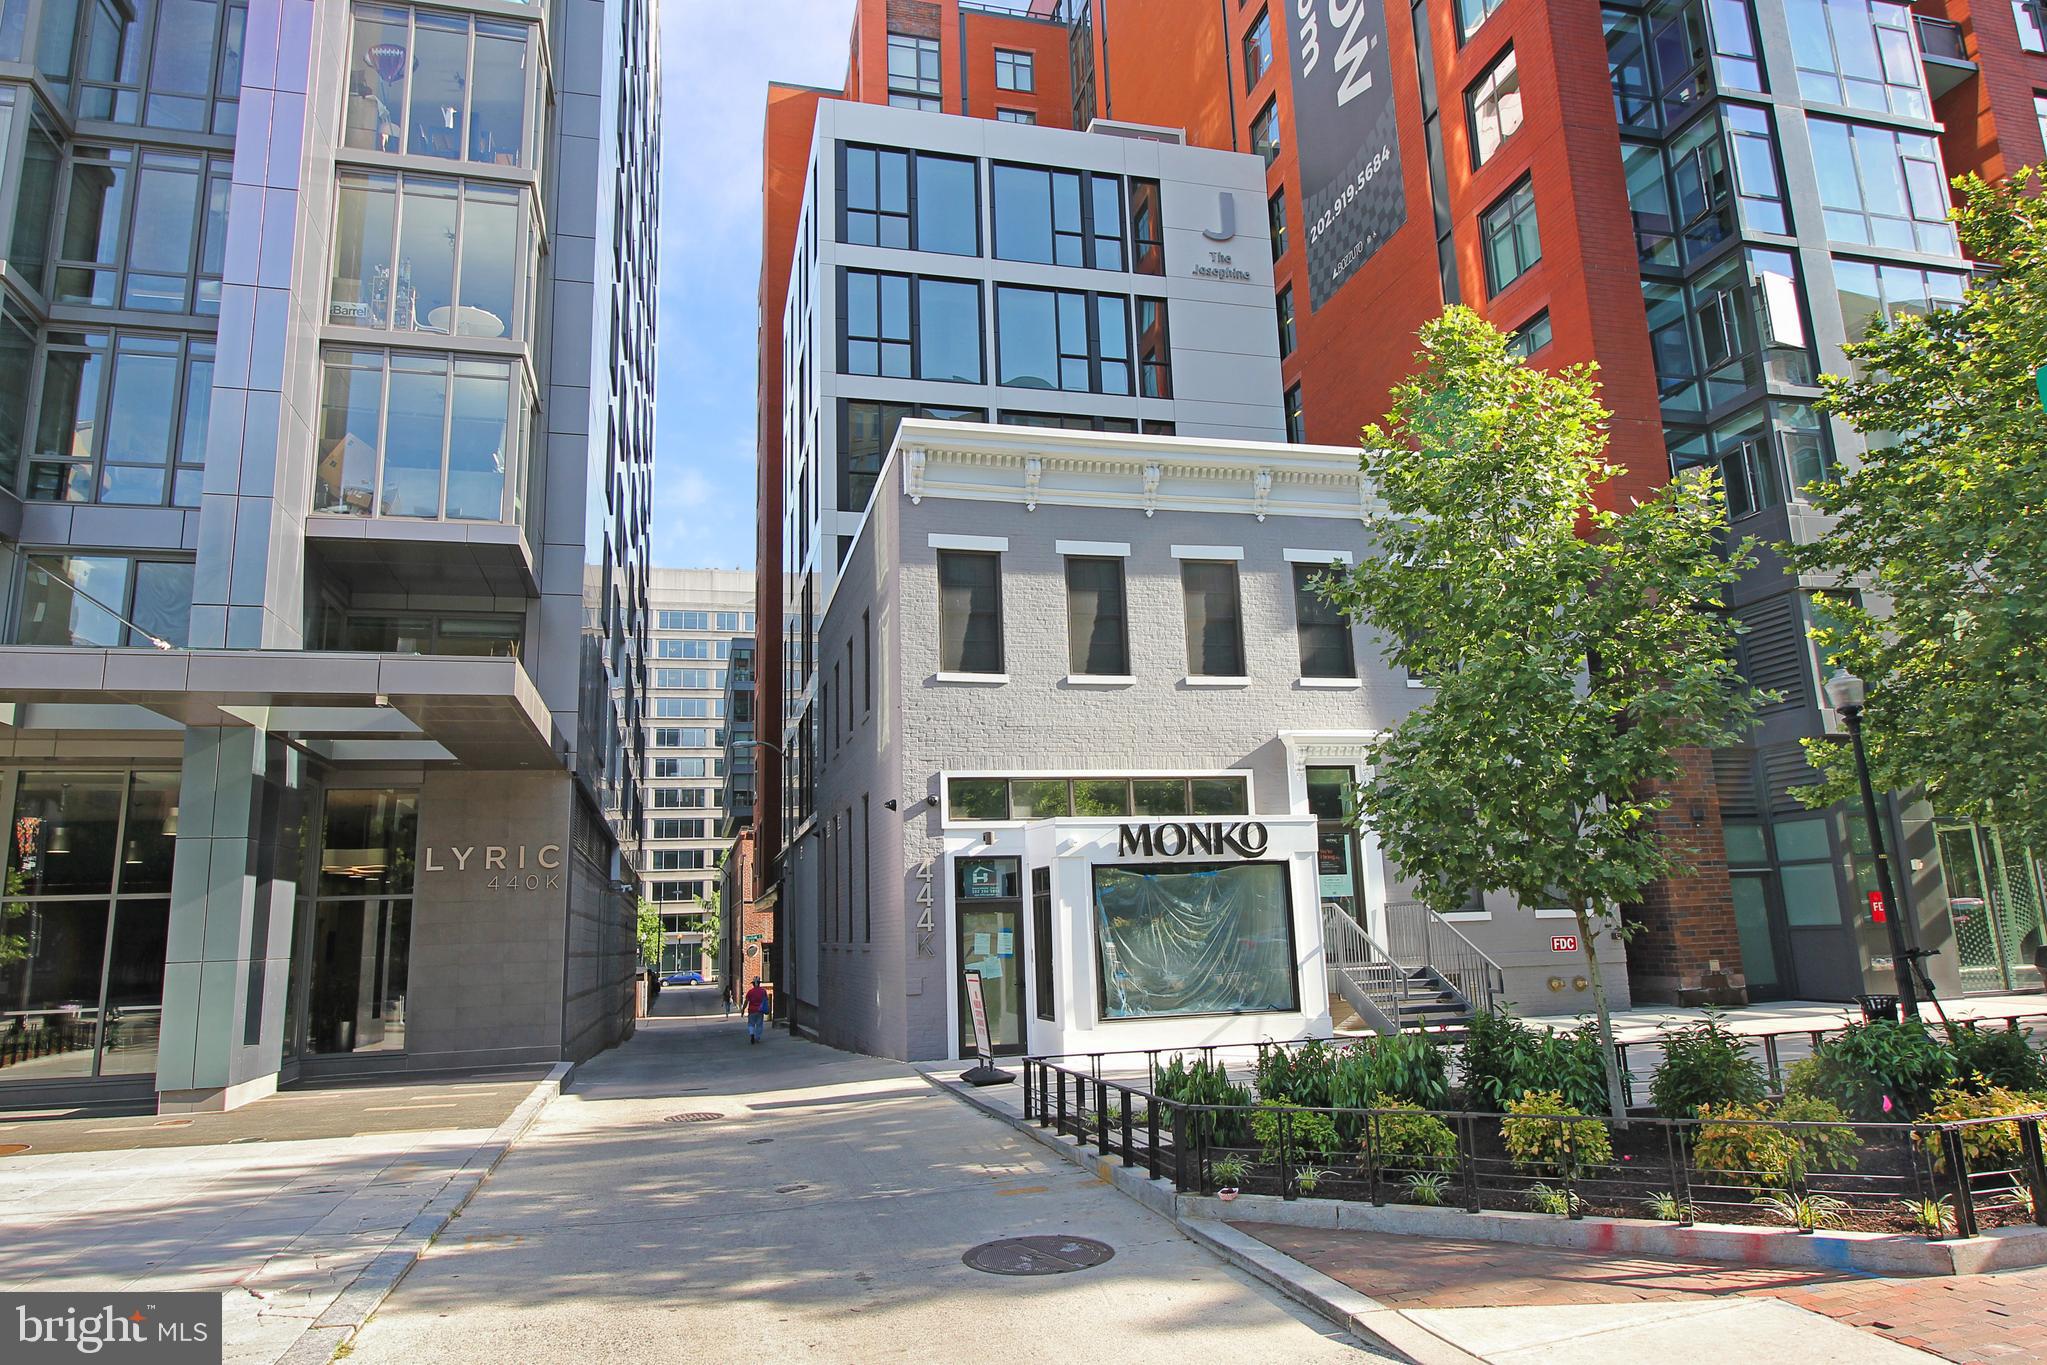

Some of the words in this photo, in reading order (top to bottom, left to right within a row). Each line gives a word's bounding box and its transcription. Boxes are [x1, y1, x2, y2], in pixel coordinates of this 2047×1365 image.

[1310, 145, 1391, 244] 202.919.5684
[1202, 192, 1235, 241] J
[1209, 251, 1232, 264] The
[1192, 264, 1251, 280] Josephine
[330, 305, 367, 316] Barrel
[1118, 821, 1269, 859] MONKO
[425, 844, 561, 871] LYRIC
[487, 874, 560, 891] 440K
[1553, 938, 1575, 950] FDC
